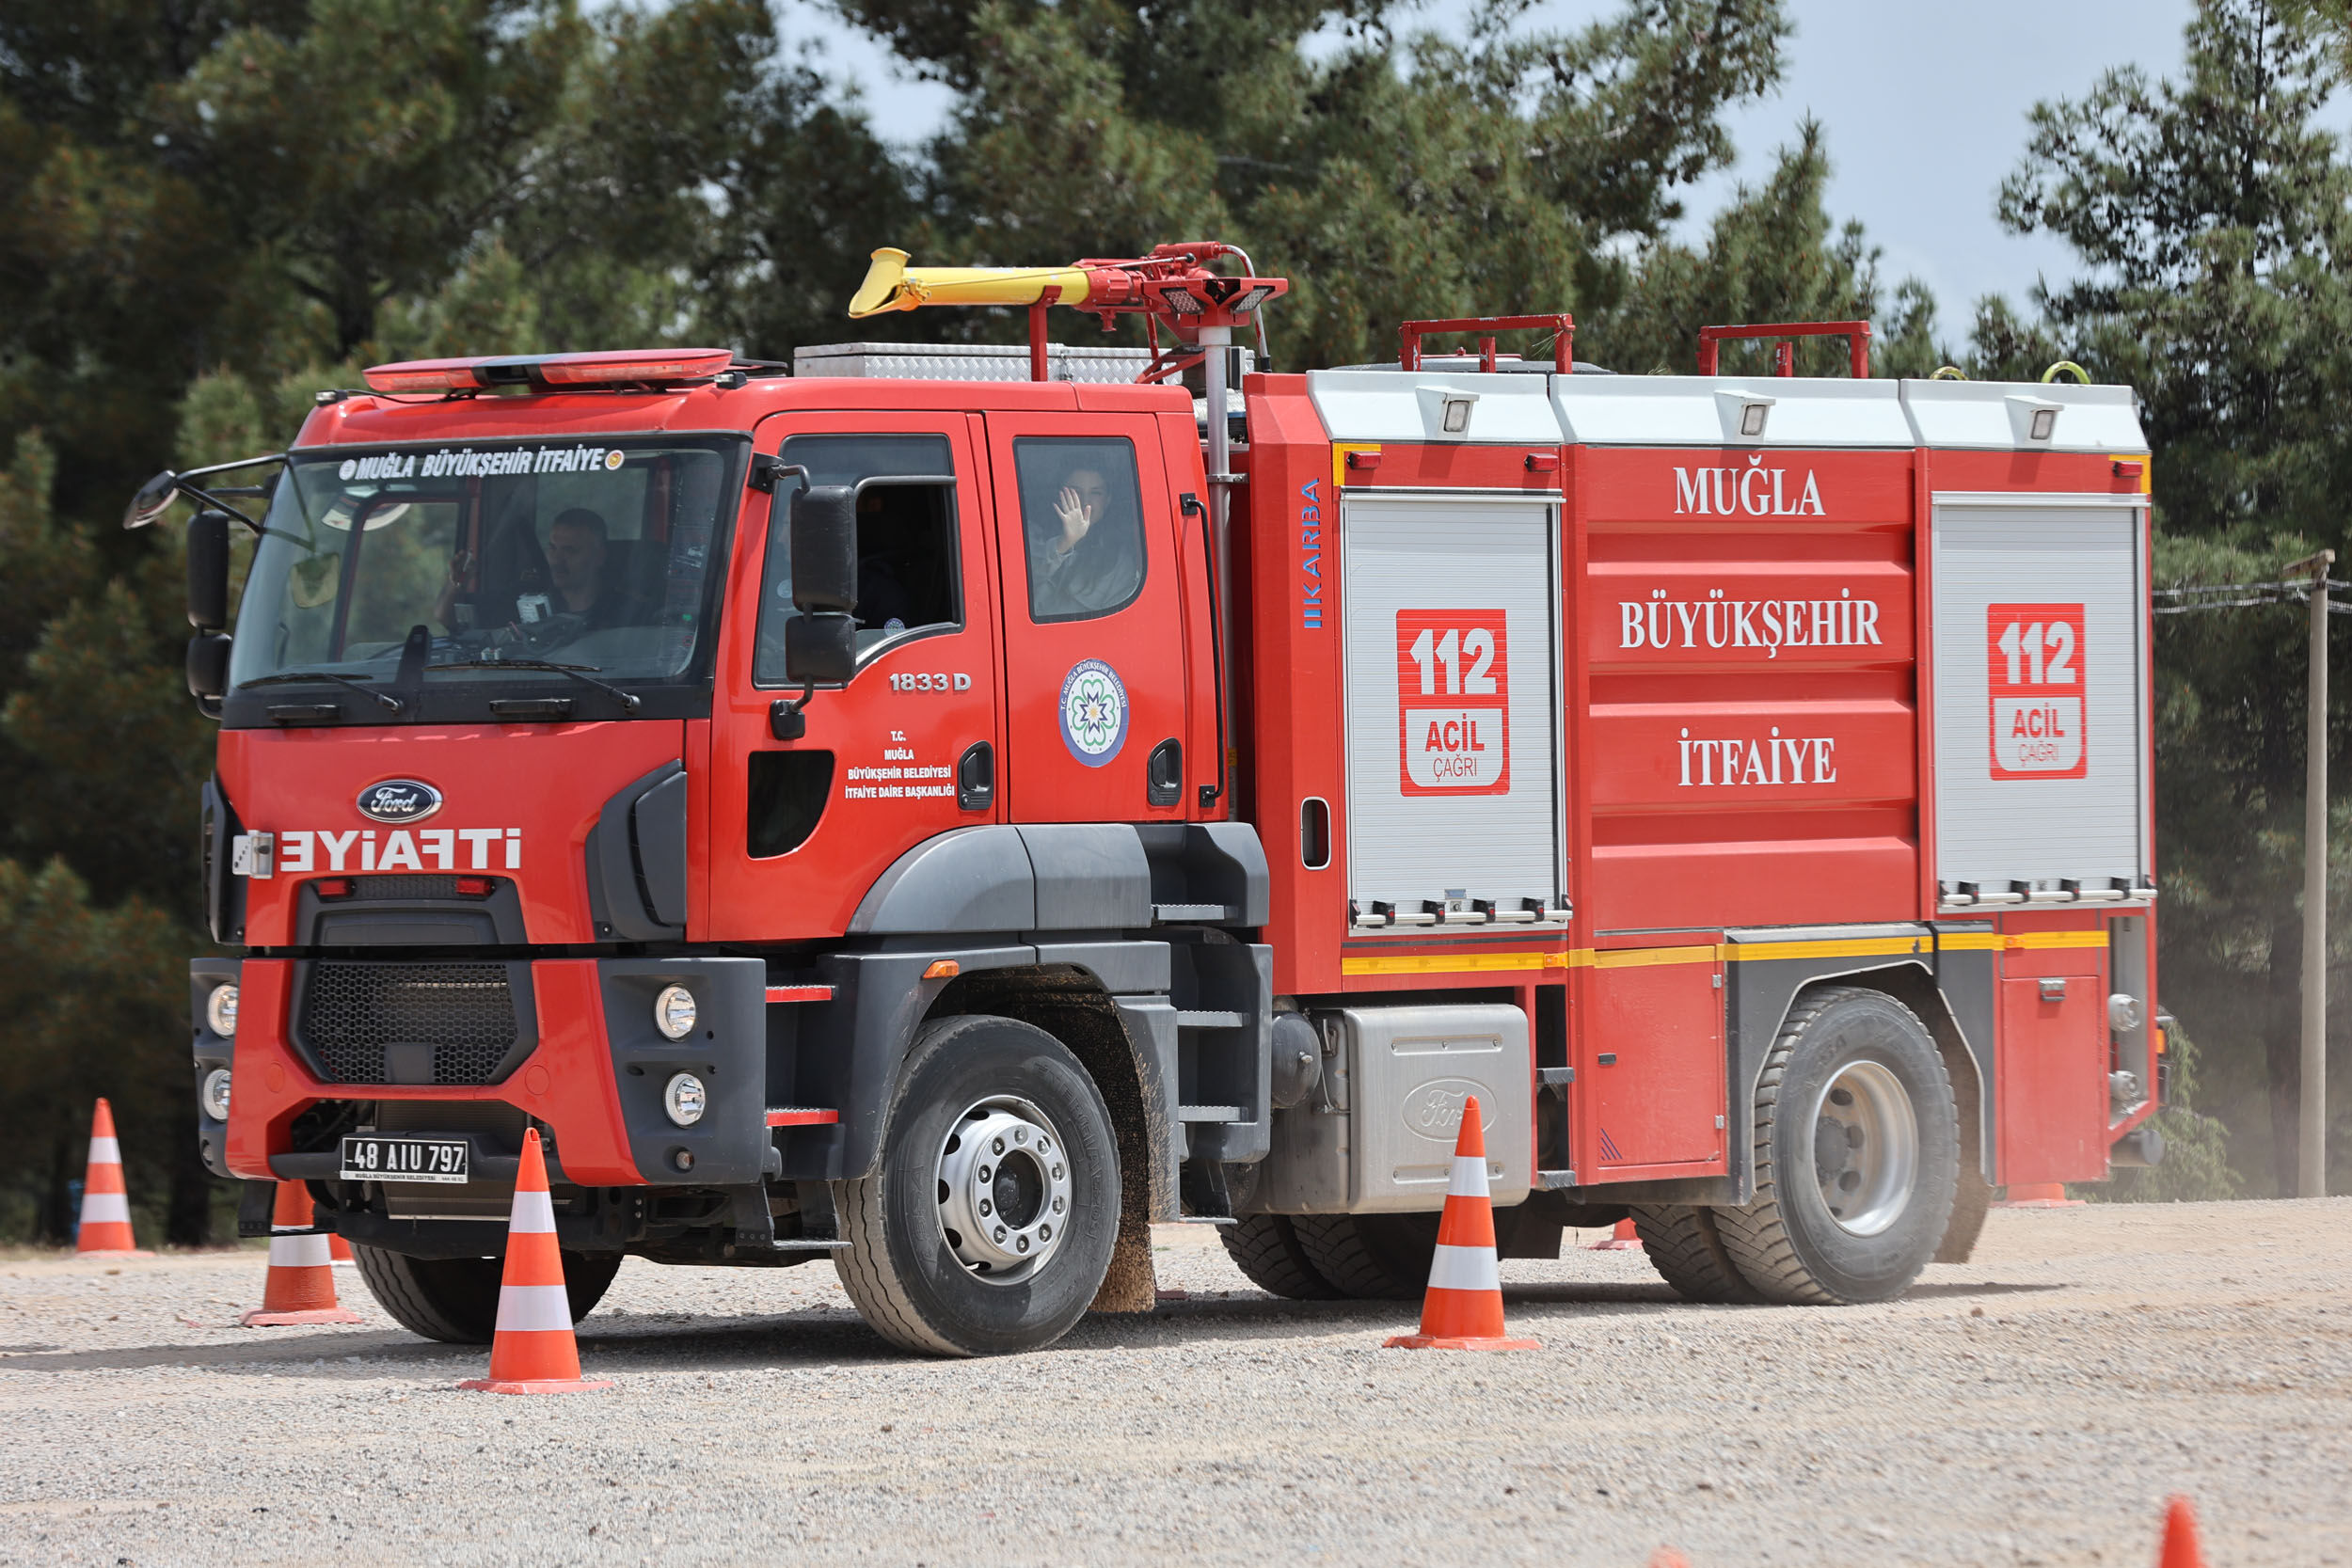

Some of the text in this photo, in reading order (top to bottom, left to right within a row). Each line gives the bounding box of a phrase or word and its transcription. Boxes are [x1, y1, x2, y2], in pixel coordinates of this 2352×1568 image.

[355, 444, 605, 480] MUĞLA BÜYÜKŞEHİR İTFAİYE
[1673, 454, 1826, 515] MUĞLA
[1618, 588, 1883, 658] BÜYÜKŞEHİR
[1409, 627, 1497, 695] 112
[1997, 621, 2076, 684] 112
[889, 673, 972, 691] 1833 D
[1424, 713, 1485, 752] ACİL
[2011, 703, 2065, 738] ACİL
[890, 731, 906, 741] T.C.
[884, 748, 914, 761] MUĞLA
[1433, 754, 1478, 782] ÇAĞRI
[1677, 726, 1836, 786] İTFAİYE
[2018, 741, 2059, 768] ÇAĞRI
[848, 765, 951, 782] BÜYÜKŞEHİR BELEDİYESİ
[371, 787, 417, 813] Ford
[845, 783, 955, 800] İTFAİYE DAİRE BAŞKANLIĞI
[354, 1142, 465, 1172] 48 AIU 797
